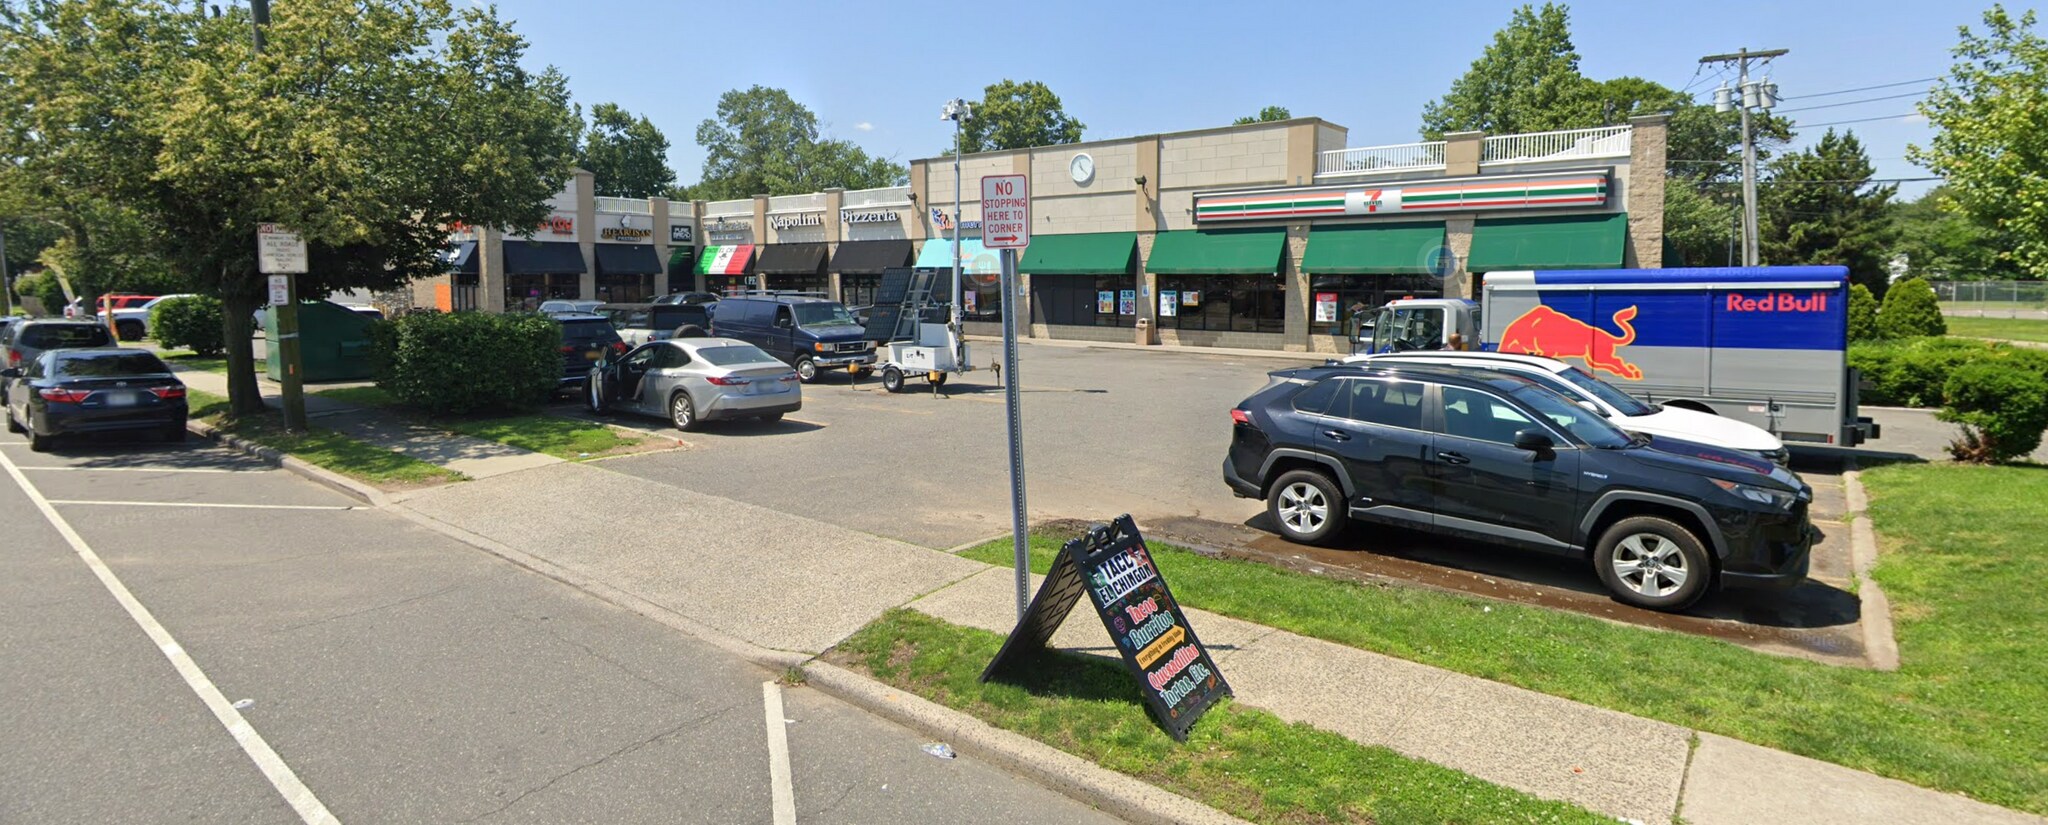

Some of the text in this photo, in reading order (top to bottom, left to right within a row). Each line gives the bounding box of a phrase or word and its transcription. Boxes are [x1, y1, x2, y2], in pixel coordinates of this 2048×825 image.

[995, 182, 1013, 196] NO
[984, 198, 1026, 209] STOPPING
[770, 209, 898, 230] Napolini Pizzeria
[987, 210, 1023, 221] HERE TO
[988, 223, 1023, 234] CORNER
[1726, 292, 1827, 312] Red Bull
[1098, 563, 1153, 604] EL CHINGON
[1125, 596, 1159, 625] Tacos
[1129, 610, 1175, 650] Burritos
[1147, 643, 1200, 691] Quesadillas
[1159, 675, 1197, 708] Tortas,
